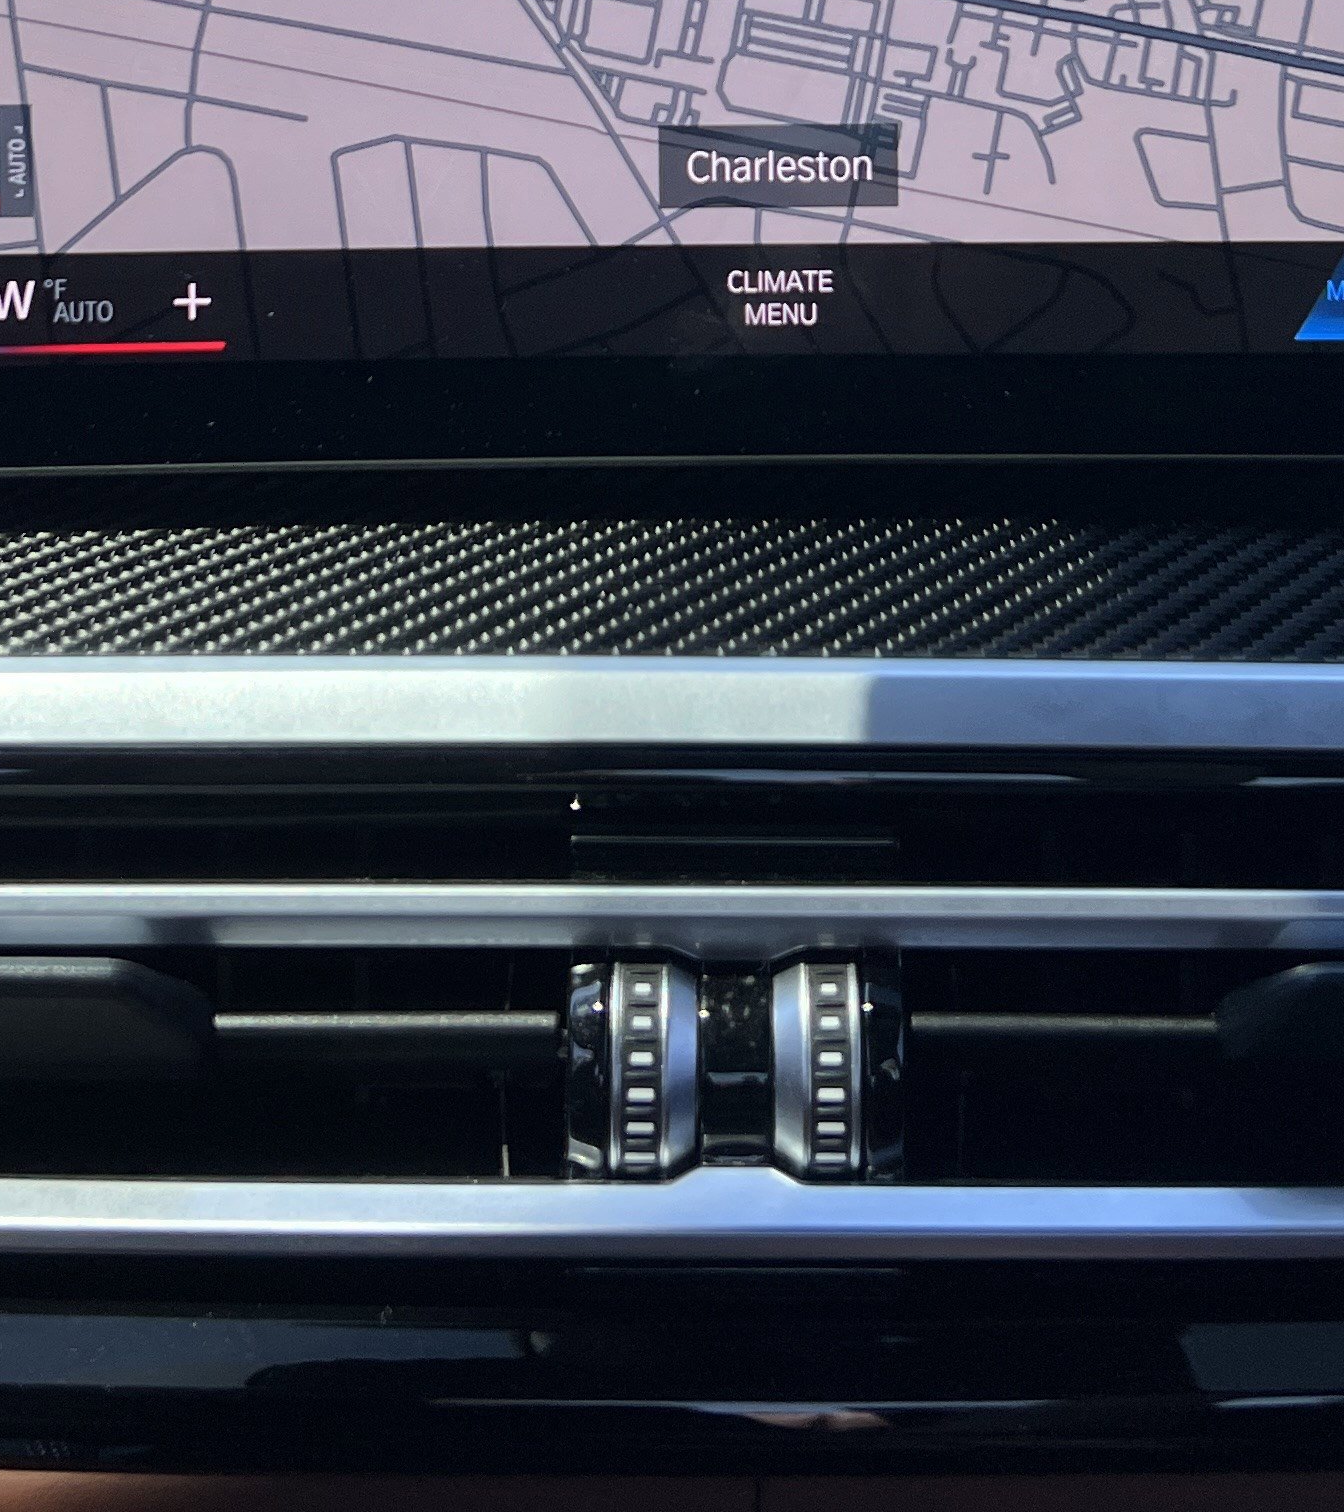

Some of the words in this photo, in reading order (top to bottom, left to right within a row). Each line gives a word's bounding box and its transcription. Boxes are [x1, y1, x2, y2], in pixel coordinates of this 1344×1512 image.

[7, 138, 27, 185] AUTO
[687, 149, 873, 184] Charleston
[726, 269, 834, 294] CLIMATE
[52, 299, 114, 323] AUTO
[744, 302, 818, 326] MENU
